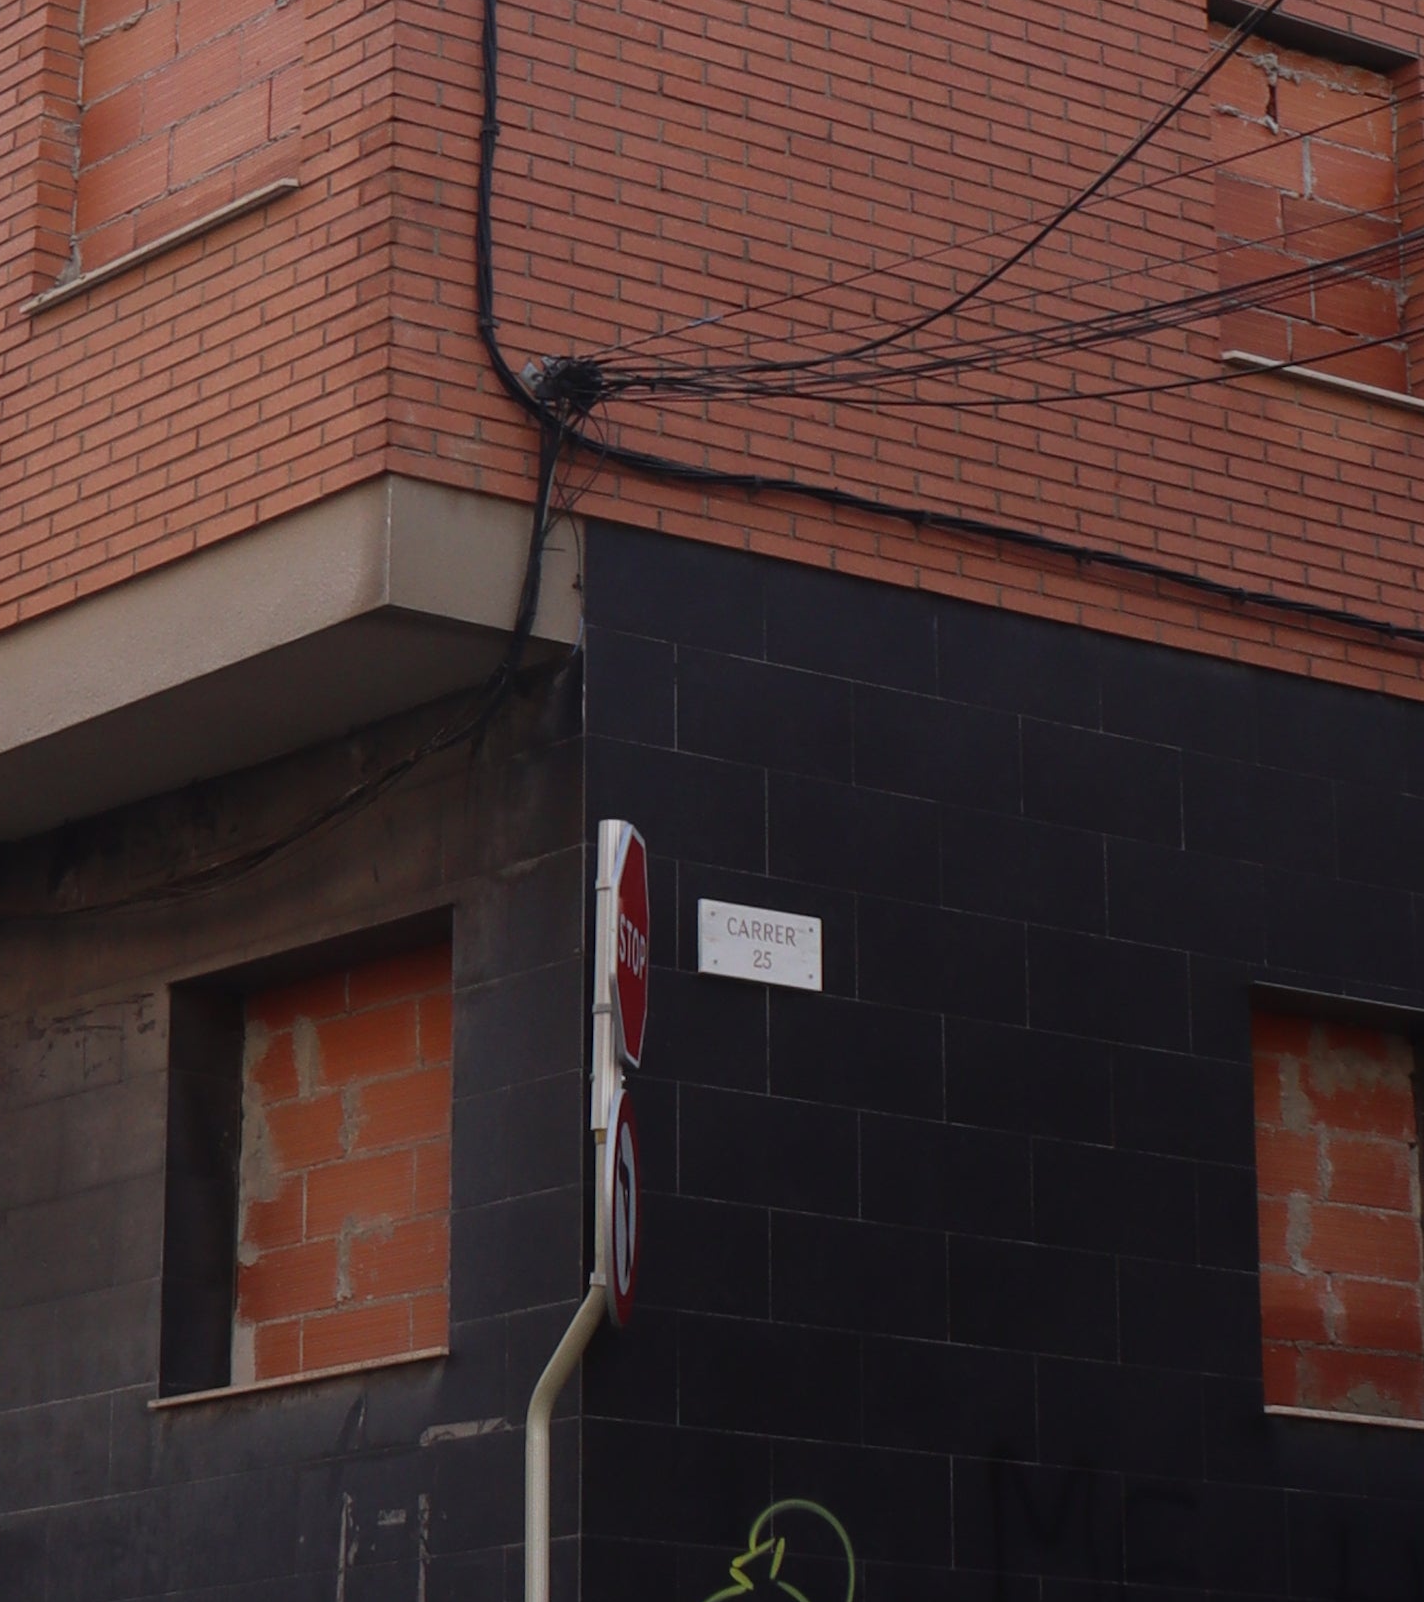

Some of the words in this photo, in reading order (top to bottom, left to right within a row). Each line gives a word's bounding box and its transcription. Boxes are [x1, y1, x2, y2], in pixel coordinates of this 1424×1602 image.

[619, 912, 646, 980] STOP
[727, 916, 797, 947] CARRER
[753, 950, 772, 970] 25
